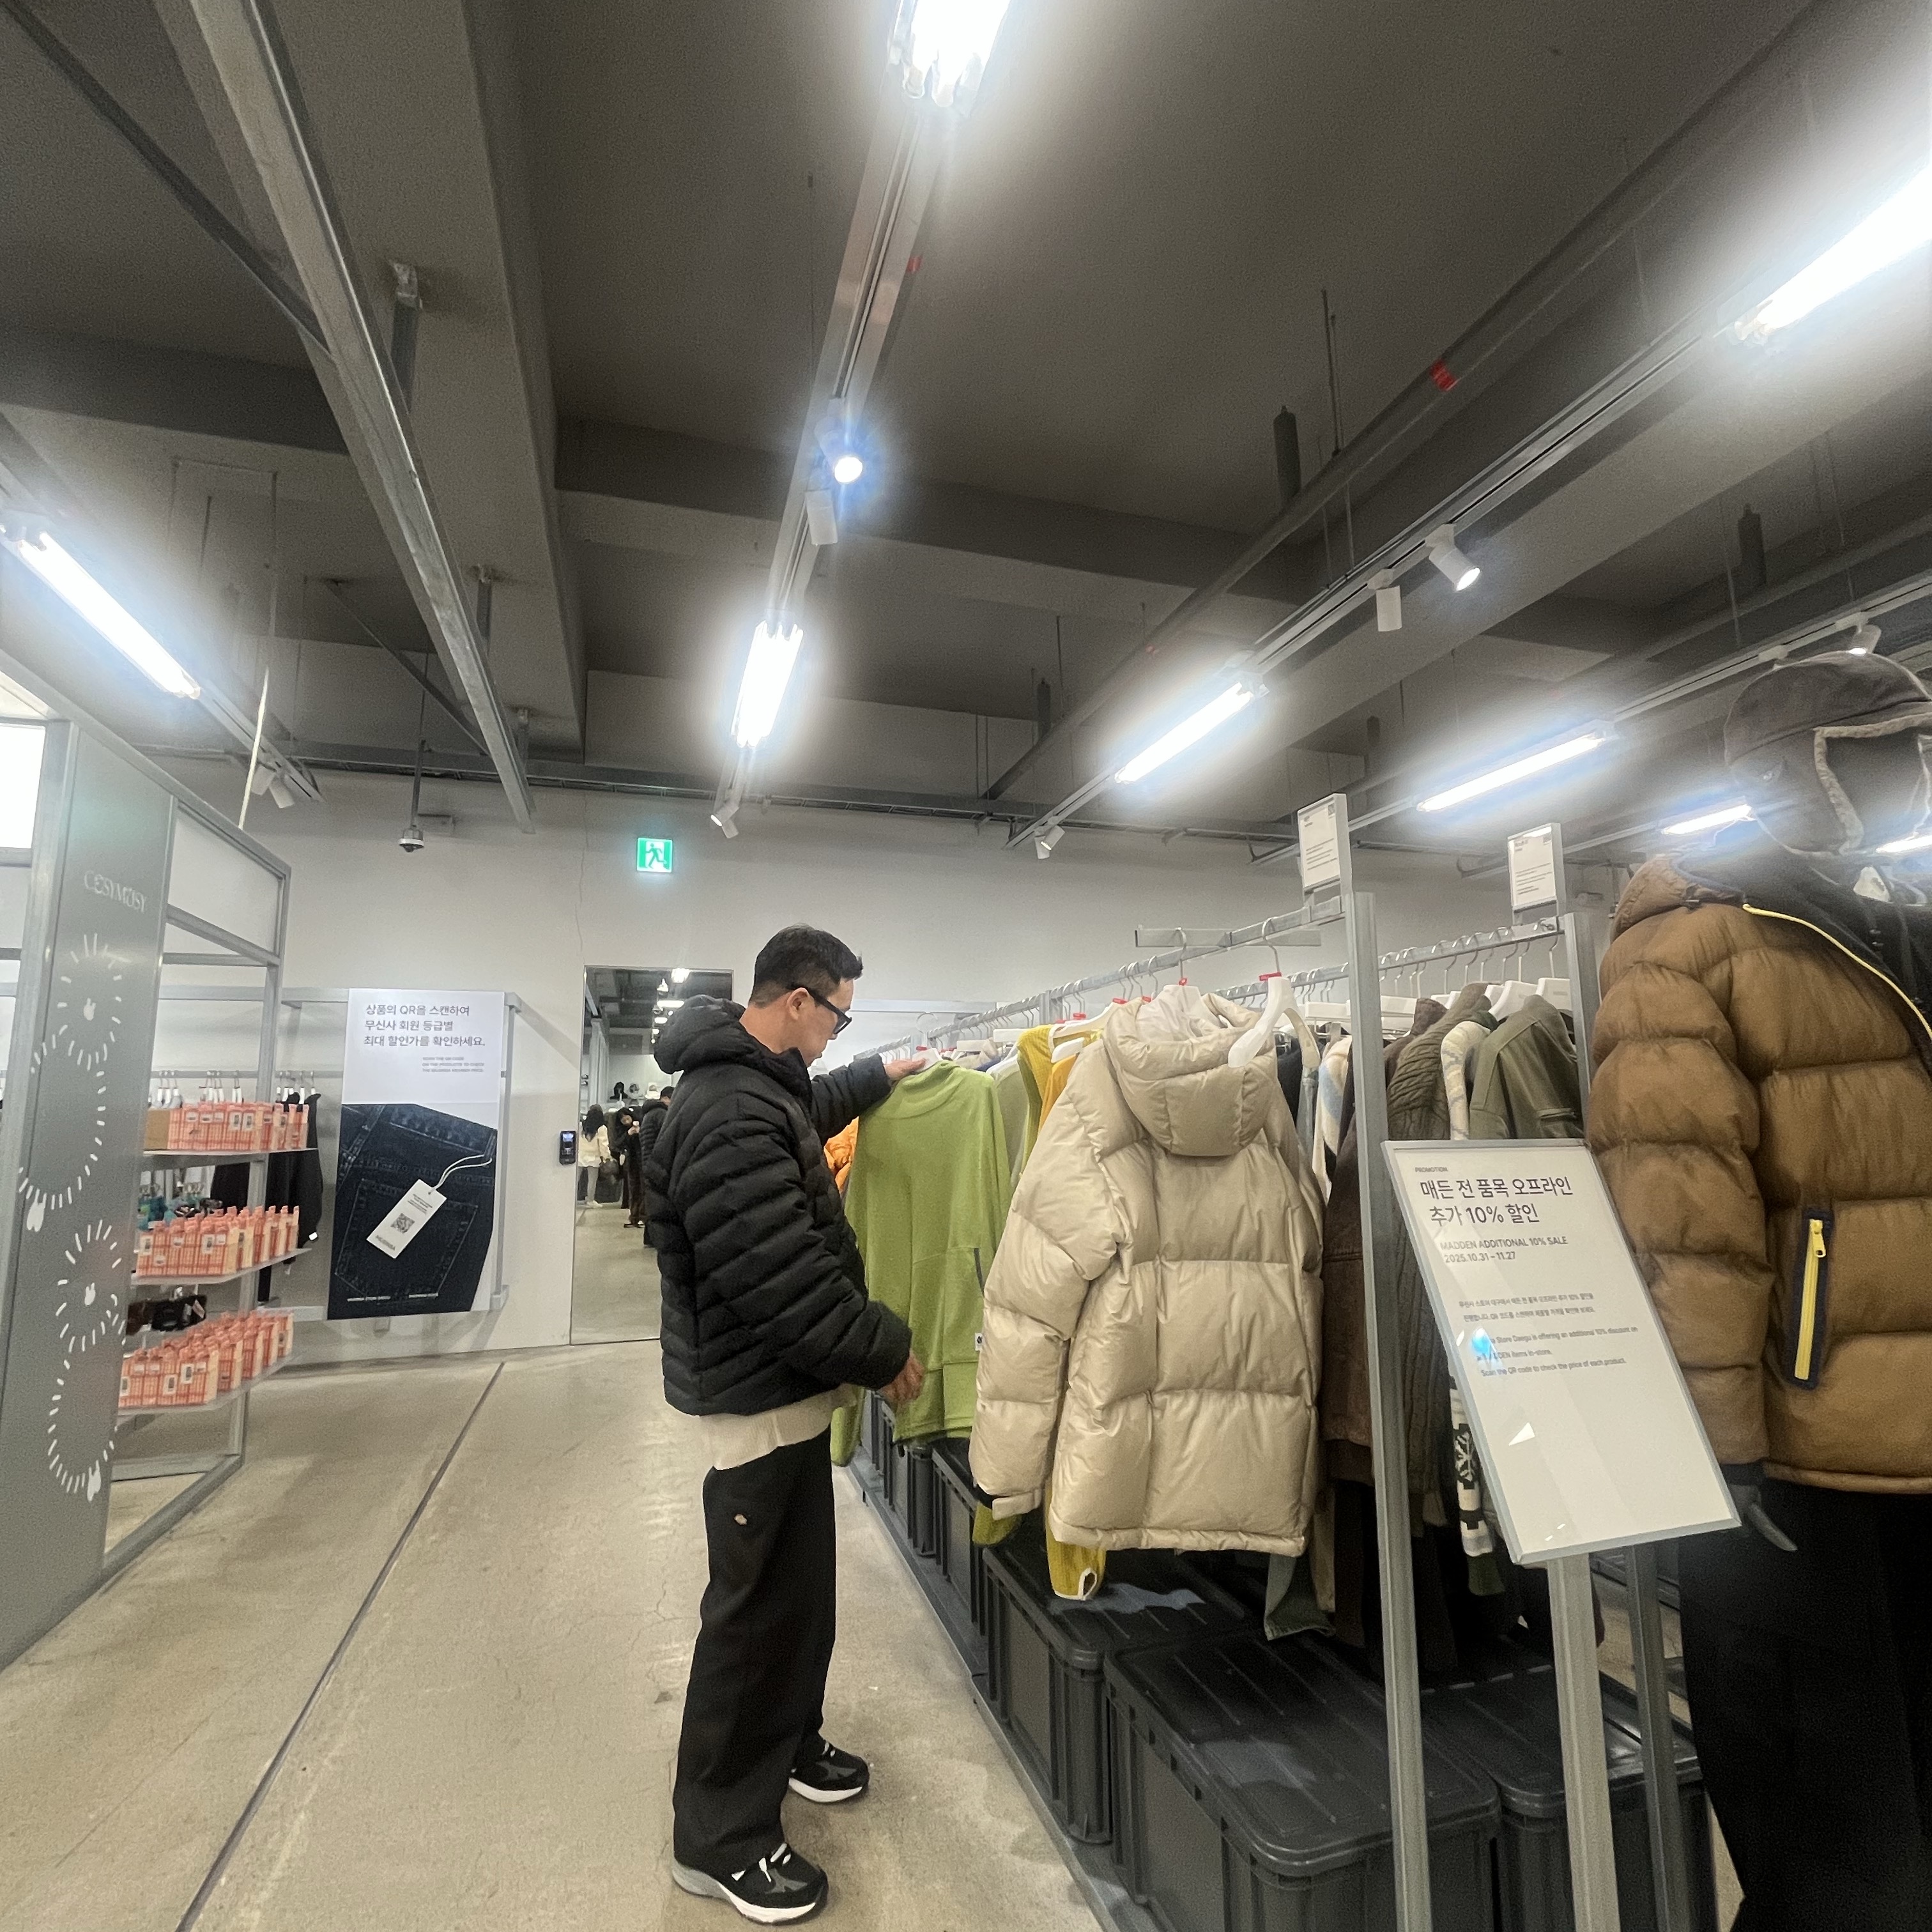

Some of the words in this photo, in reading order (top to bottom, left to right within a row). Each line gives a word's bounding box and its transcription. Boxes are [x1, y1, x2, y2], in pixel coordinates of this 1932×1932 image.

[366, 1004, 397, 1015] 상품의
[400, 1005, 426, 1016] QR을
[429, 1006, 470, 1016] 스캔하여
[365, 1020, 396, 1031] 무신사
[399, 1020, 420, 1031] 회원
[423, 1021, 454, 1031] 등급별
[364, 1036, 385, 1046] 최대
[388, 1036, 429, 1046] 할인가를
[433, 1036, 485, 1046] 확인하세요.
[1420, 1179, 1454, 1200] 매든
[1456, 1178, 1475, 1199] 전
[1476, 1178, 1509, 1198] 품목
[1512, 1176, 1574, 1196] 오프라인
[1429, 1205, 1463, 1227] 추가
[1465, 1206, 1504, 1223] 10%
[1505, 1203, 1540, 1223] 할인
[1440, 1239, 1477, 1250] MADDEN
[1478, 1238, 1529, 1248] ADDITIONAL
[1529, 1238, 1546, 1246] 10%
[1547, 1236, 1568, 1245] SALE
[1445, 1252, 1489, 1263] 2025.10.31
[1496, 1251, 1515, 1260] 11.27
